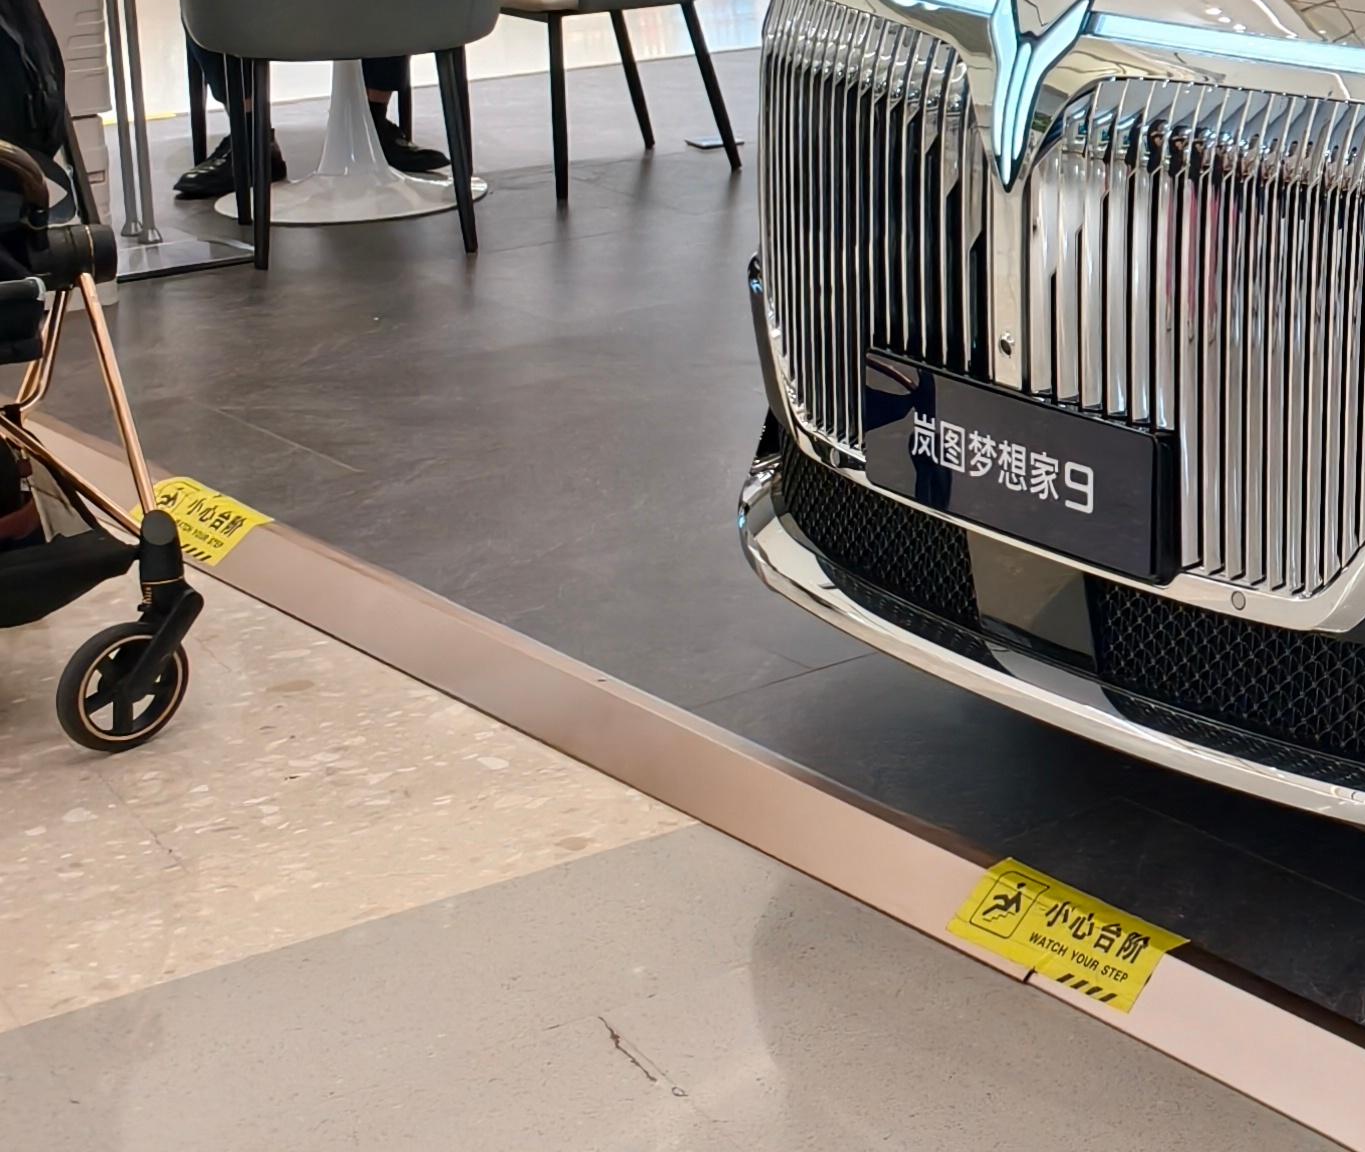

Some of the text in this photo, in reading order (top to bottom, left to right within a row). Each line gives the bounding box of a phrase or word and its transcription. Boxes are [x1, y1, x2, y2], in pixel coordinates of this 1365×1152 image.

[910, 411, 1096, 515] 岚图梦想家9
[187, 496, 249, 538] 小心台阶
[1029, 931, 1129, 984] WATCH YOUR STEP
[1045, 901, 1152, 965] 小心台阶
